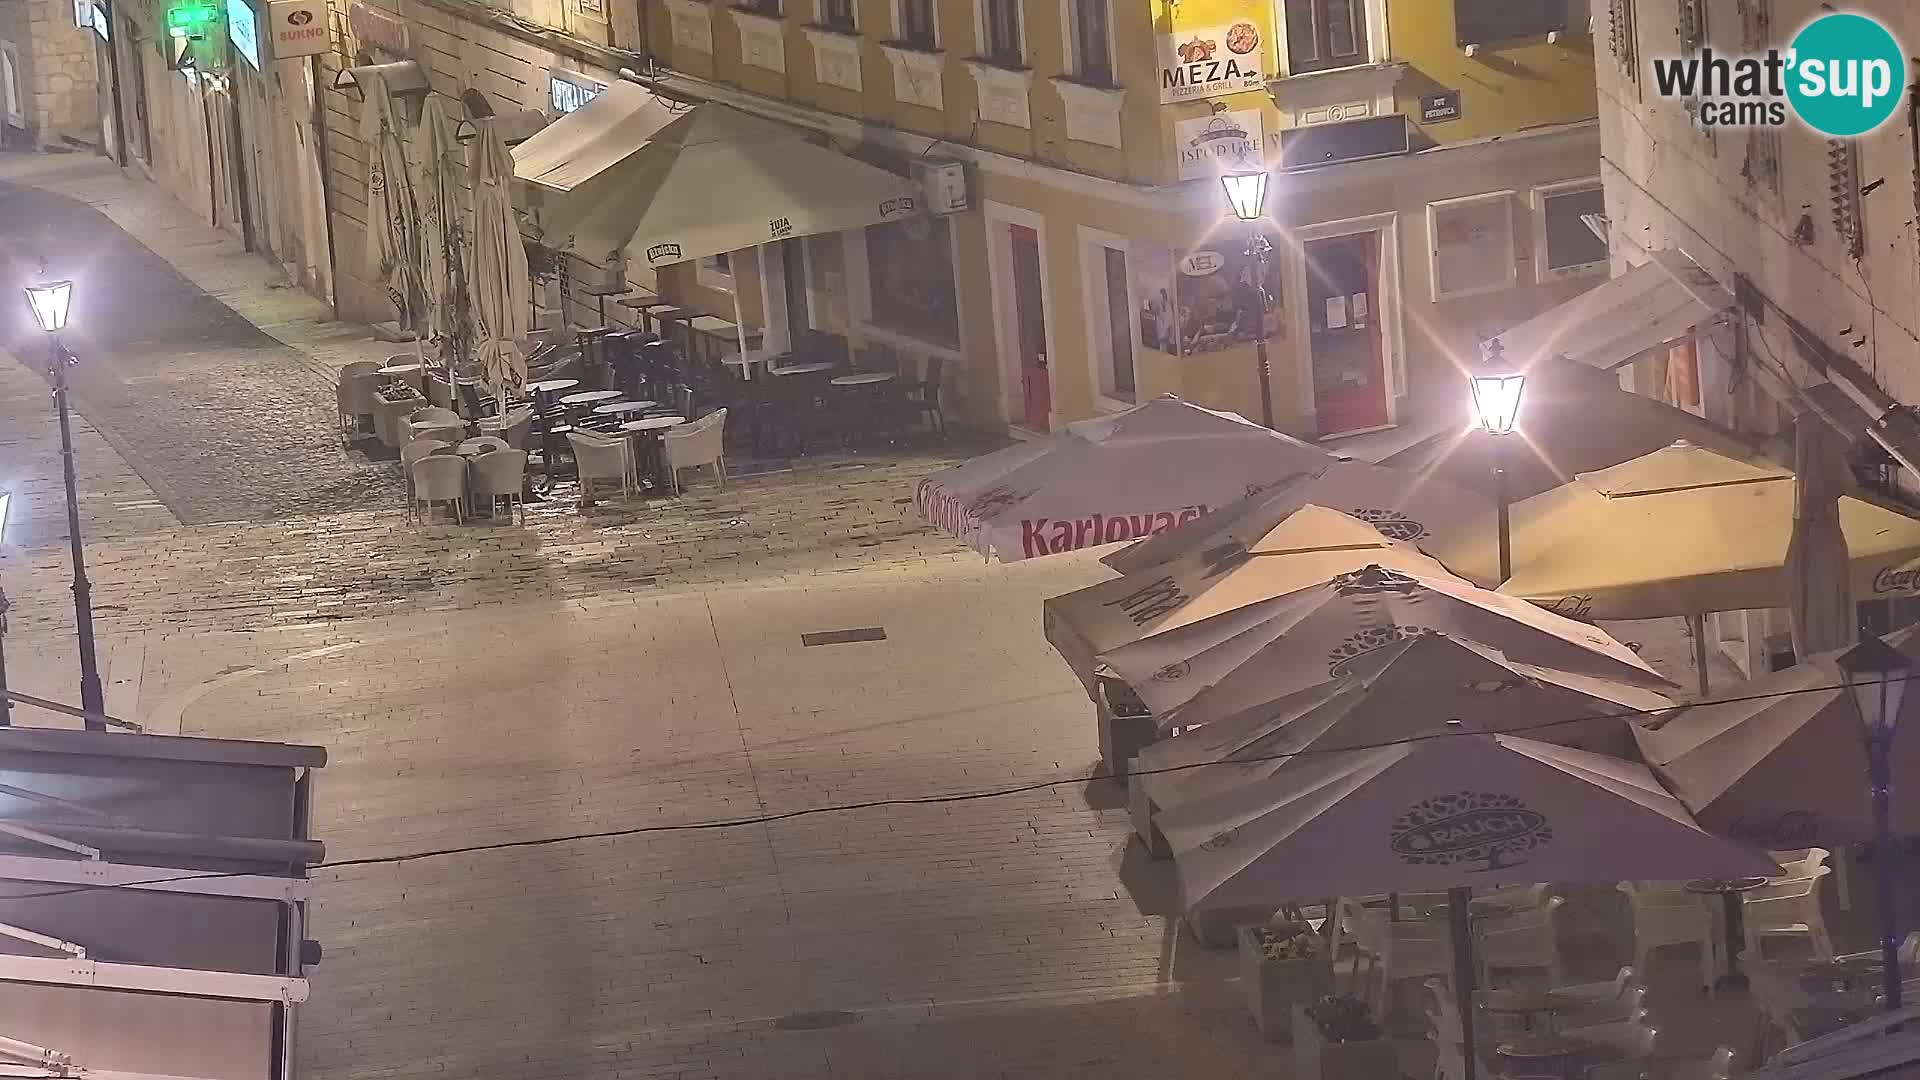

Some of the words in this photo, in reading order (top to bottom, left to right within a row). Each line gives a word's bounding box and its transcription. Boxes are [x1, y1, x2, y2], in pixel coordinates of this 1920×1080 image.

[1162, 58, 1241, 89] MEZA
[1171, 84, 1205, 97] PIZZERIA
[1212, 80, 1233, 91] GRILL
